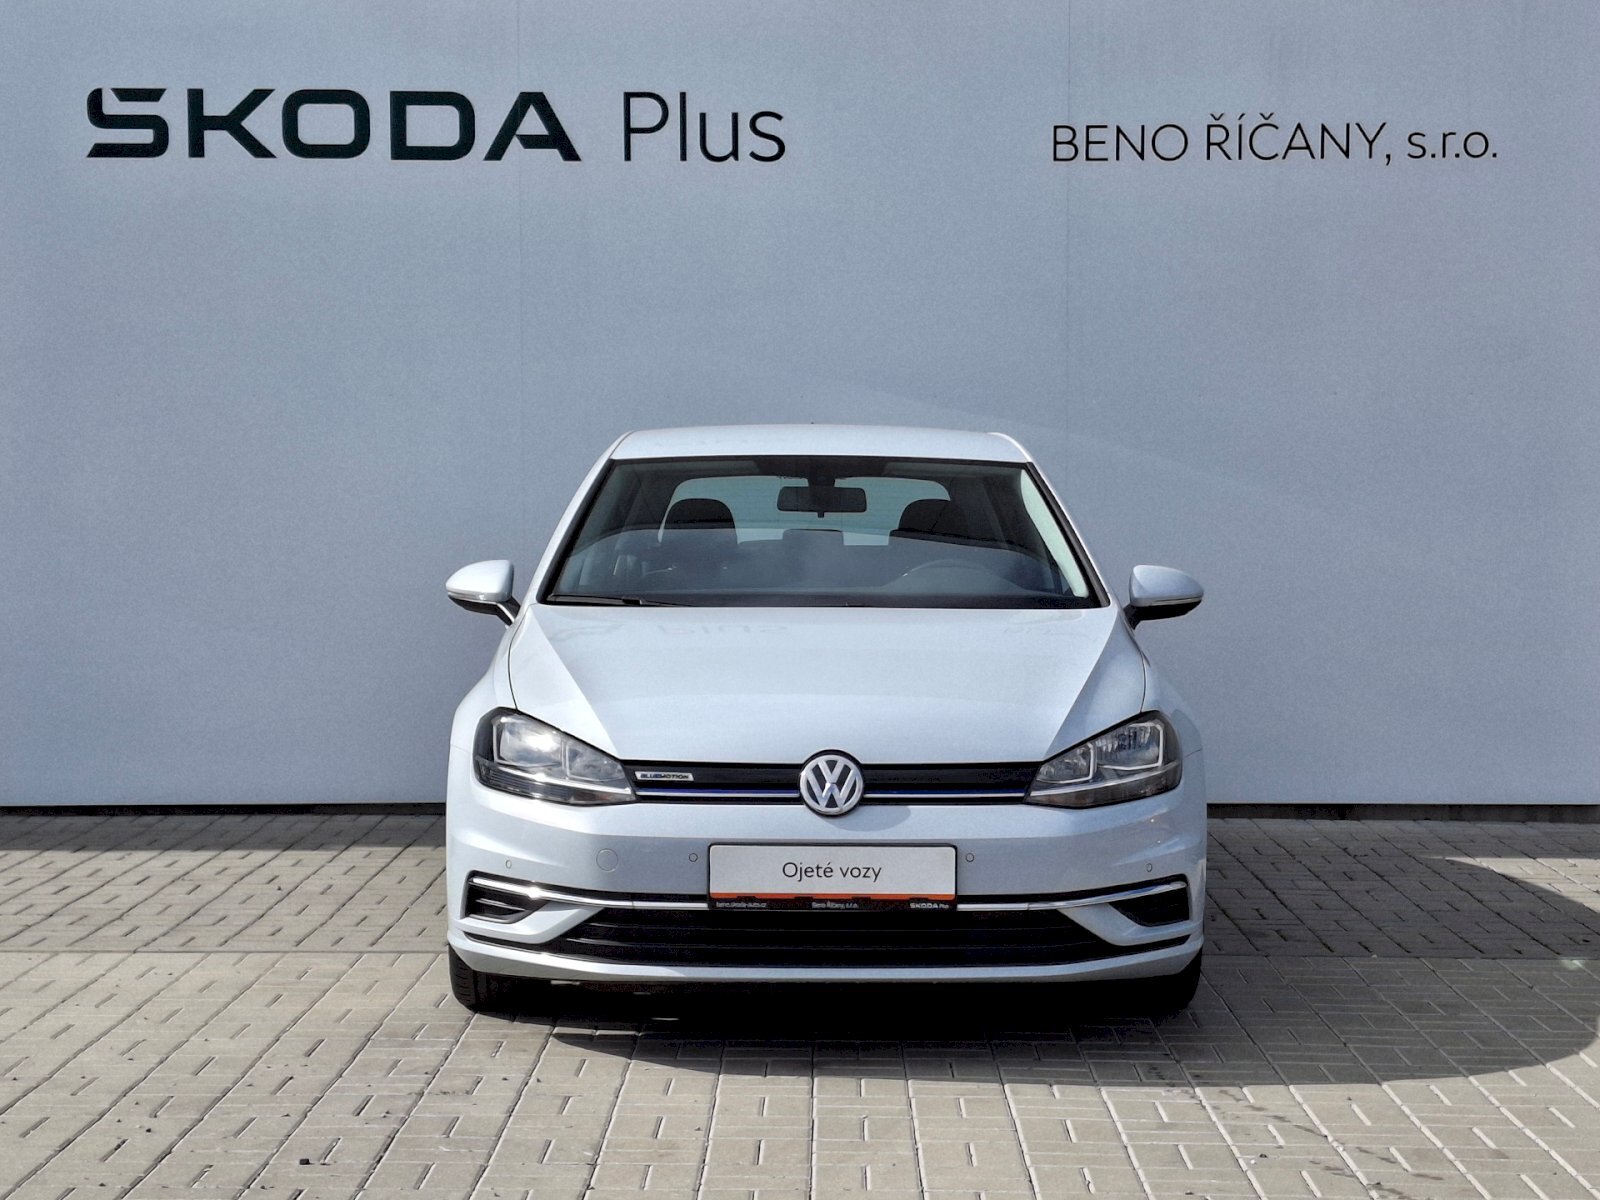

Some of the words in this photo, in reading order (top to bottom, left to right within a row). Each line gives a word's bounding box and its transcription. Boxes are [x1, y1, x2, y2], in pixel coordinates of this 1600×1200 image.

[623, 91, 786, 162] Plus
[1052, 123, 1189, 162] BENO
[1206, 112, 1392, 167] ŘÍČANY,
[1407, 131, 1498, 160] s.r.o.
[782, 861, 834, 883] Ojeté
[839, 866, 882, 883] vozy
